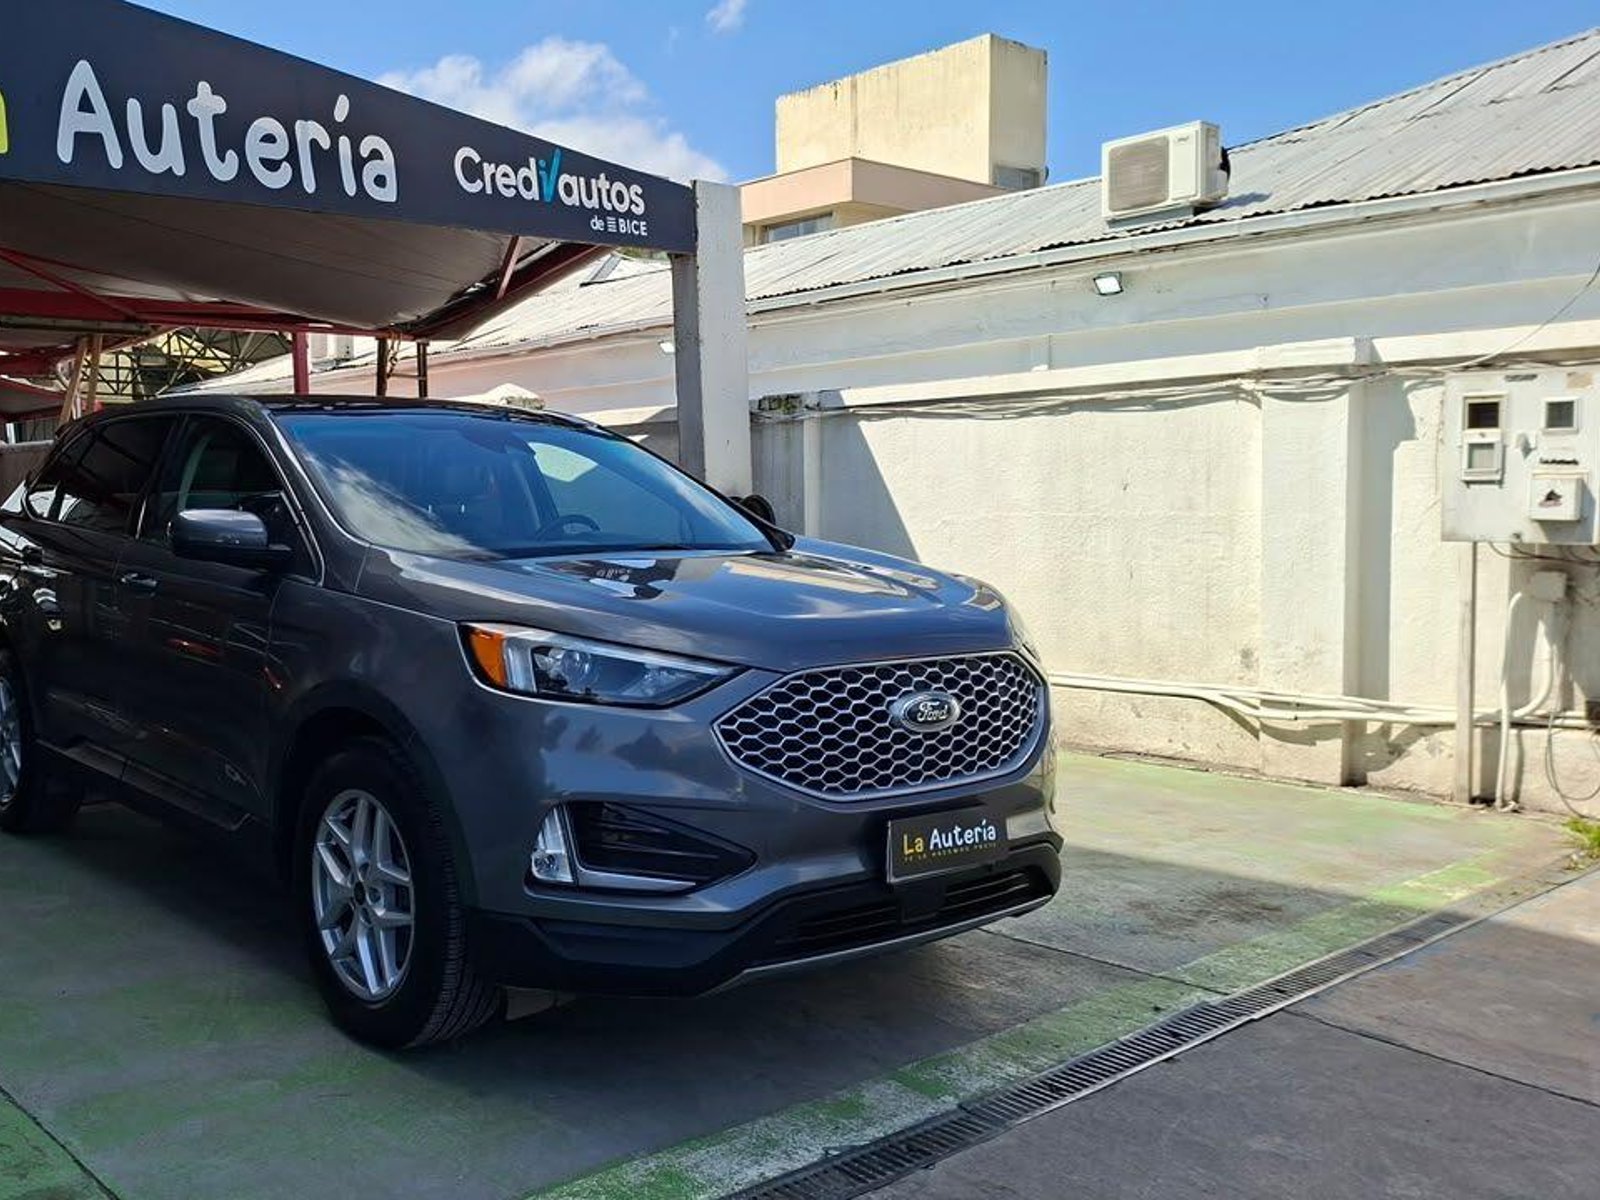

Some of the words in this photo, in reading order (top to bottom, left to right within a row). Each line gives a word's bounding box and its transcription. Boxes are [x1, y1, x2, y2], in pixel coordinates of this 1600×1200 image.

[57, 59, 398, 203] Autería
[590, 215, 605, 232] de
[618, 219, 648, 236] BICE
[917, 701, 948, 722] Ford
[902, 833, 925, 856] La
[929, 818, 997, 851] Autería
